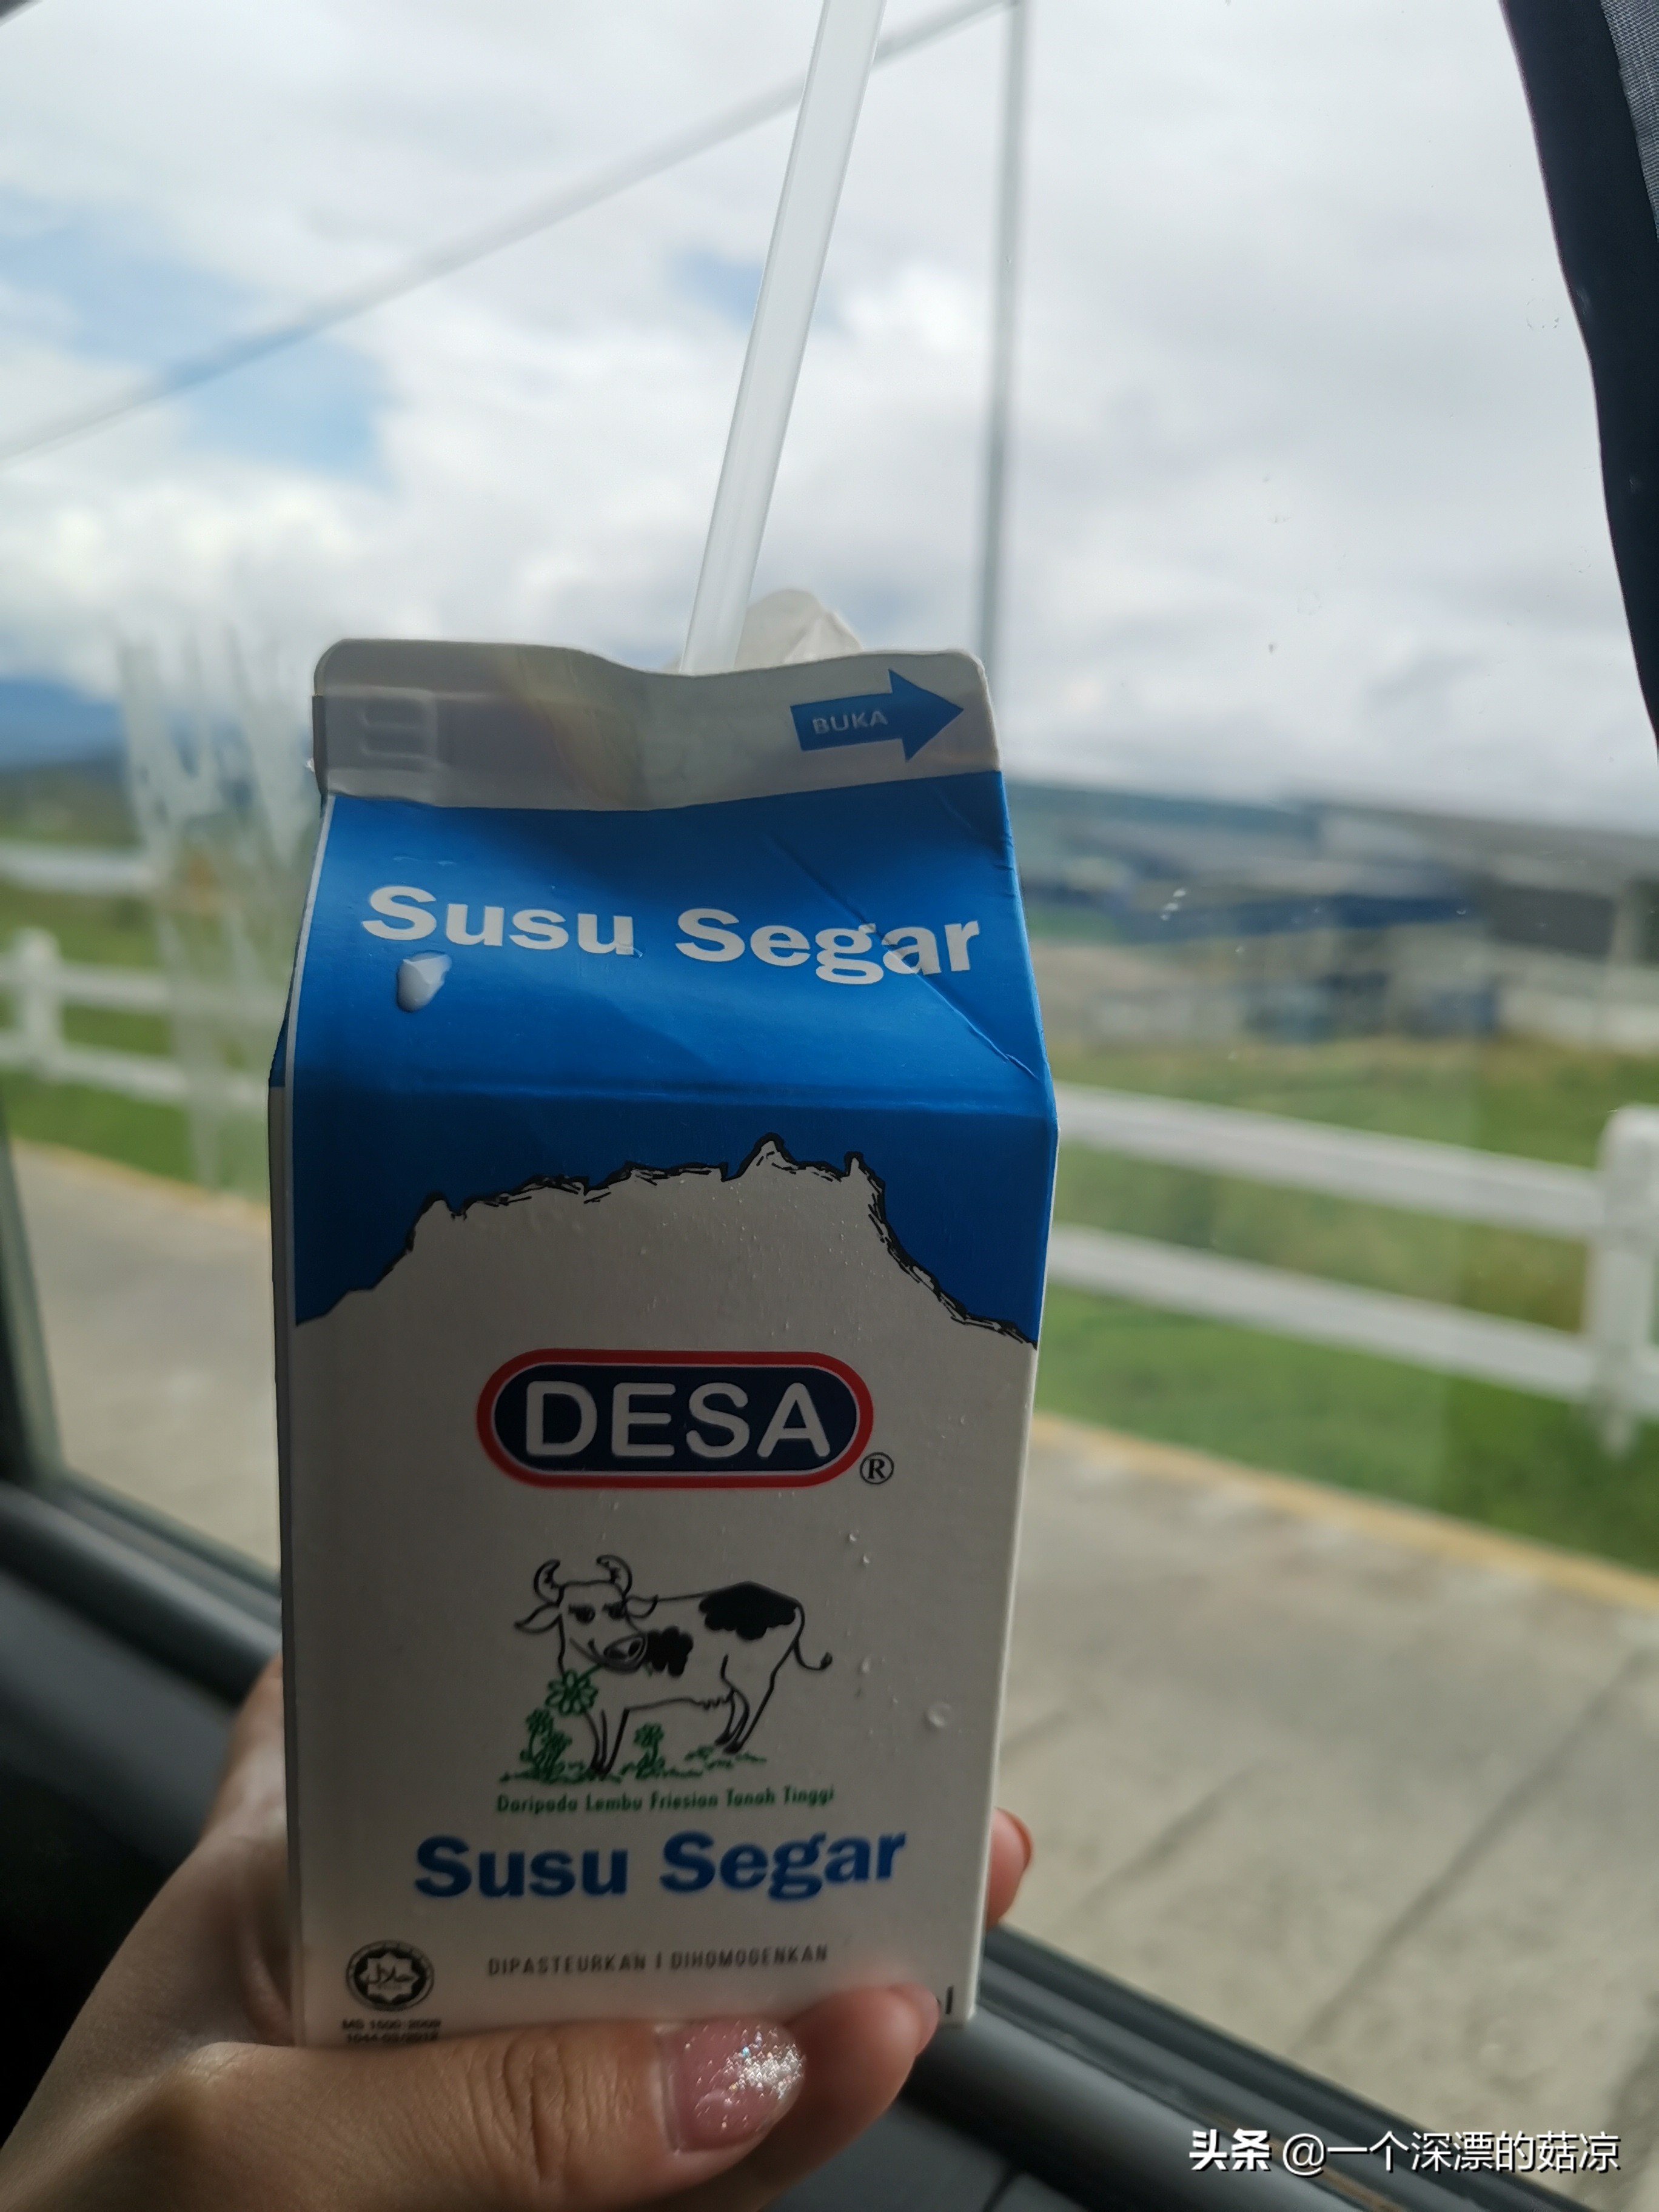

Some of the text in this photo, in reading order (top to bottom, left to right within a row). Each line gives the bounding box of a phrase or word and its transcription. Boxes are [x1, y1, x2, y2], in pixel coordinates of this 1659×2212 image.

[812, 711, 888, 734] BUKA
[363, 885, 980, 985] Susu Segar
[526, 1381, 831, 1458] DESA
[496, 1785, 835, 1814] Daripada Lembu Friesian Tanah Tinggi
[414, 1831, 906, 1901] Susu Segar
[488, 1952, 646, 1976] DIPASTEURKAN
[671, 1944, 828, 1971] DIHOMOGENKAN
